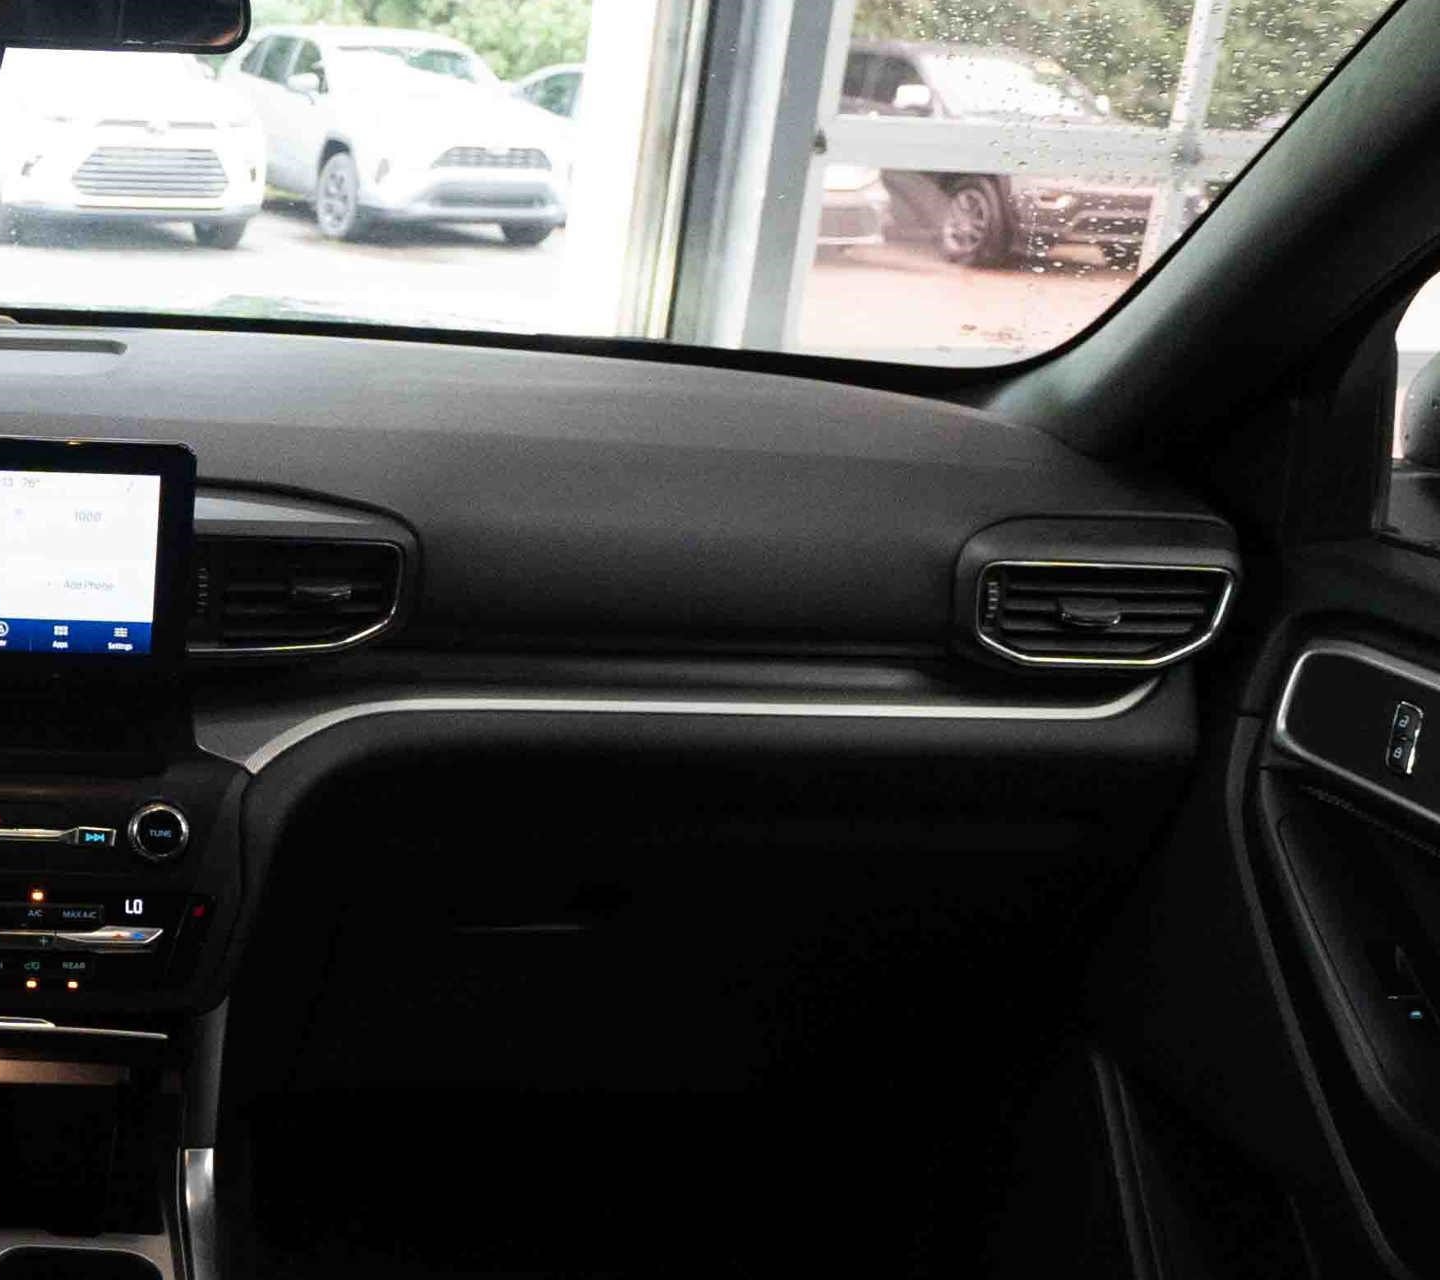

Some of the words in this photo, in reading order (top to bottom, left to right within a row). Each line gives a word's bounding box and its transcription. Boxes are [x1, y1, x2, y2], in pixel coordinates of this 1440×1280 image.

[52, 641, 68, 649] Apps
[108, 642, 133, 652] Settings
[148, 828, 172, 838] TUNE
[125, 898, 143, 914] LO
